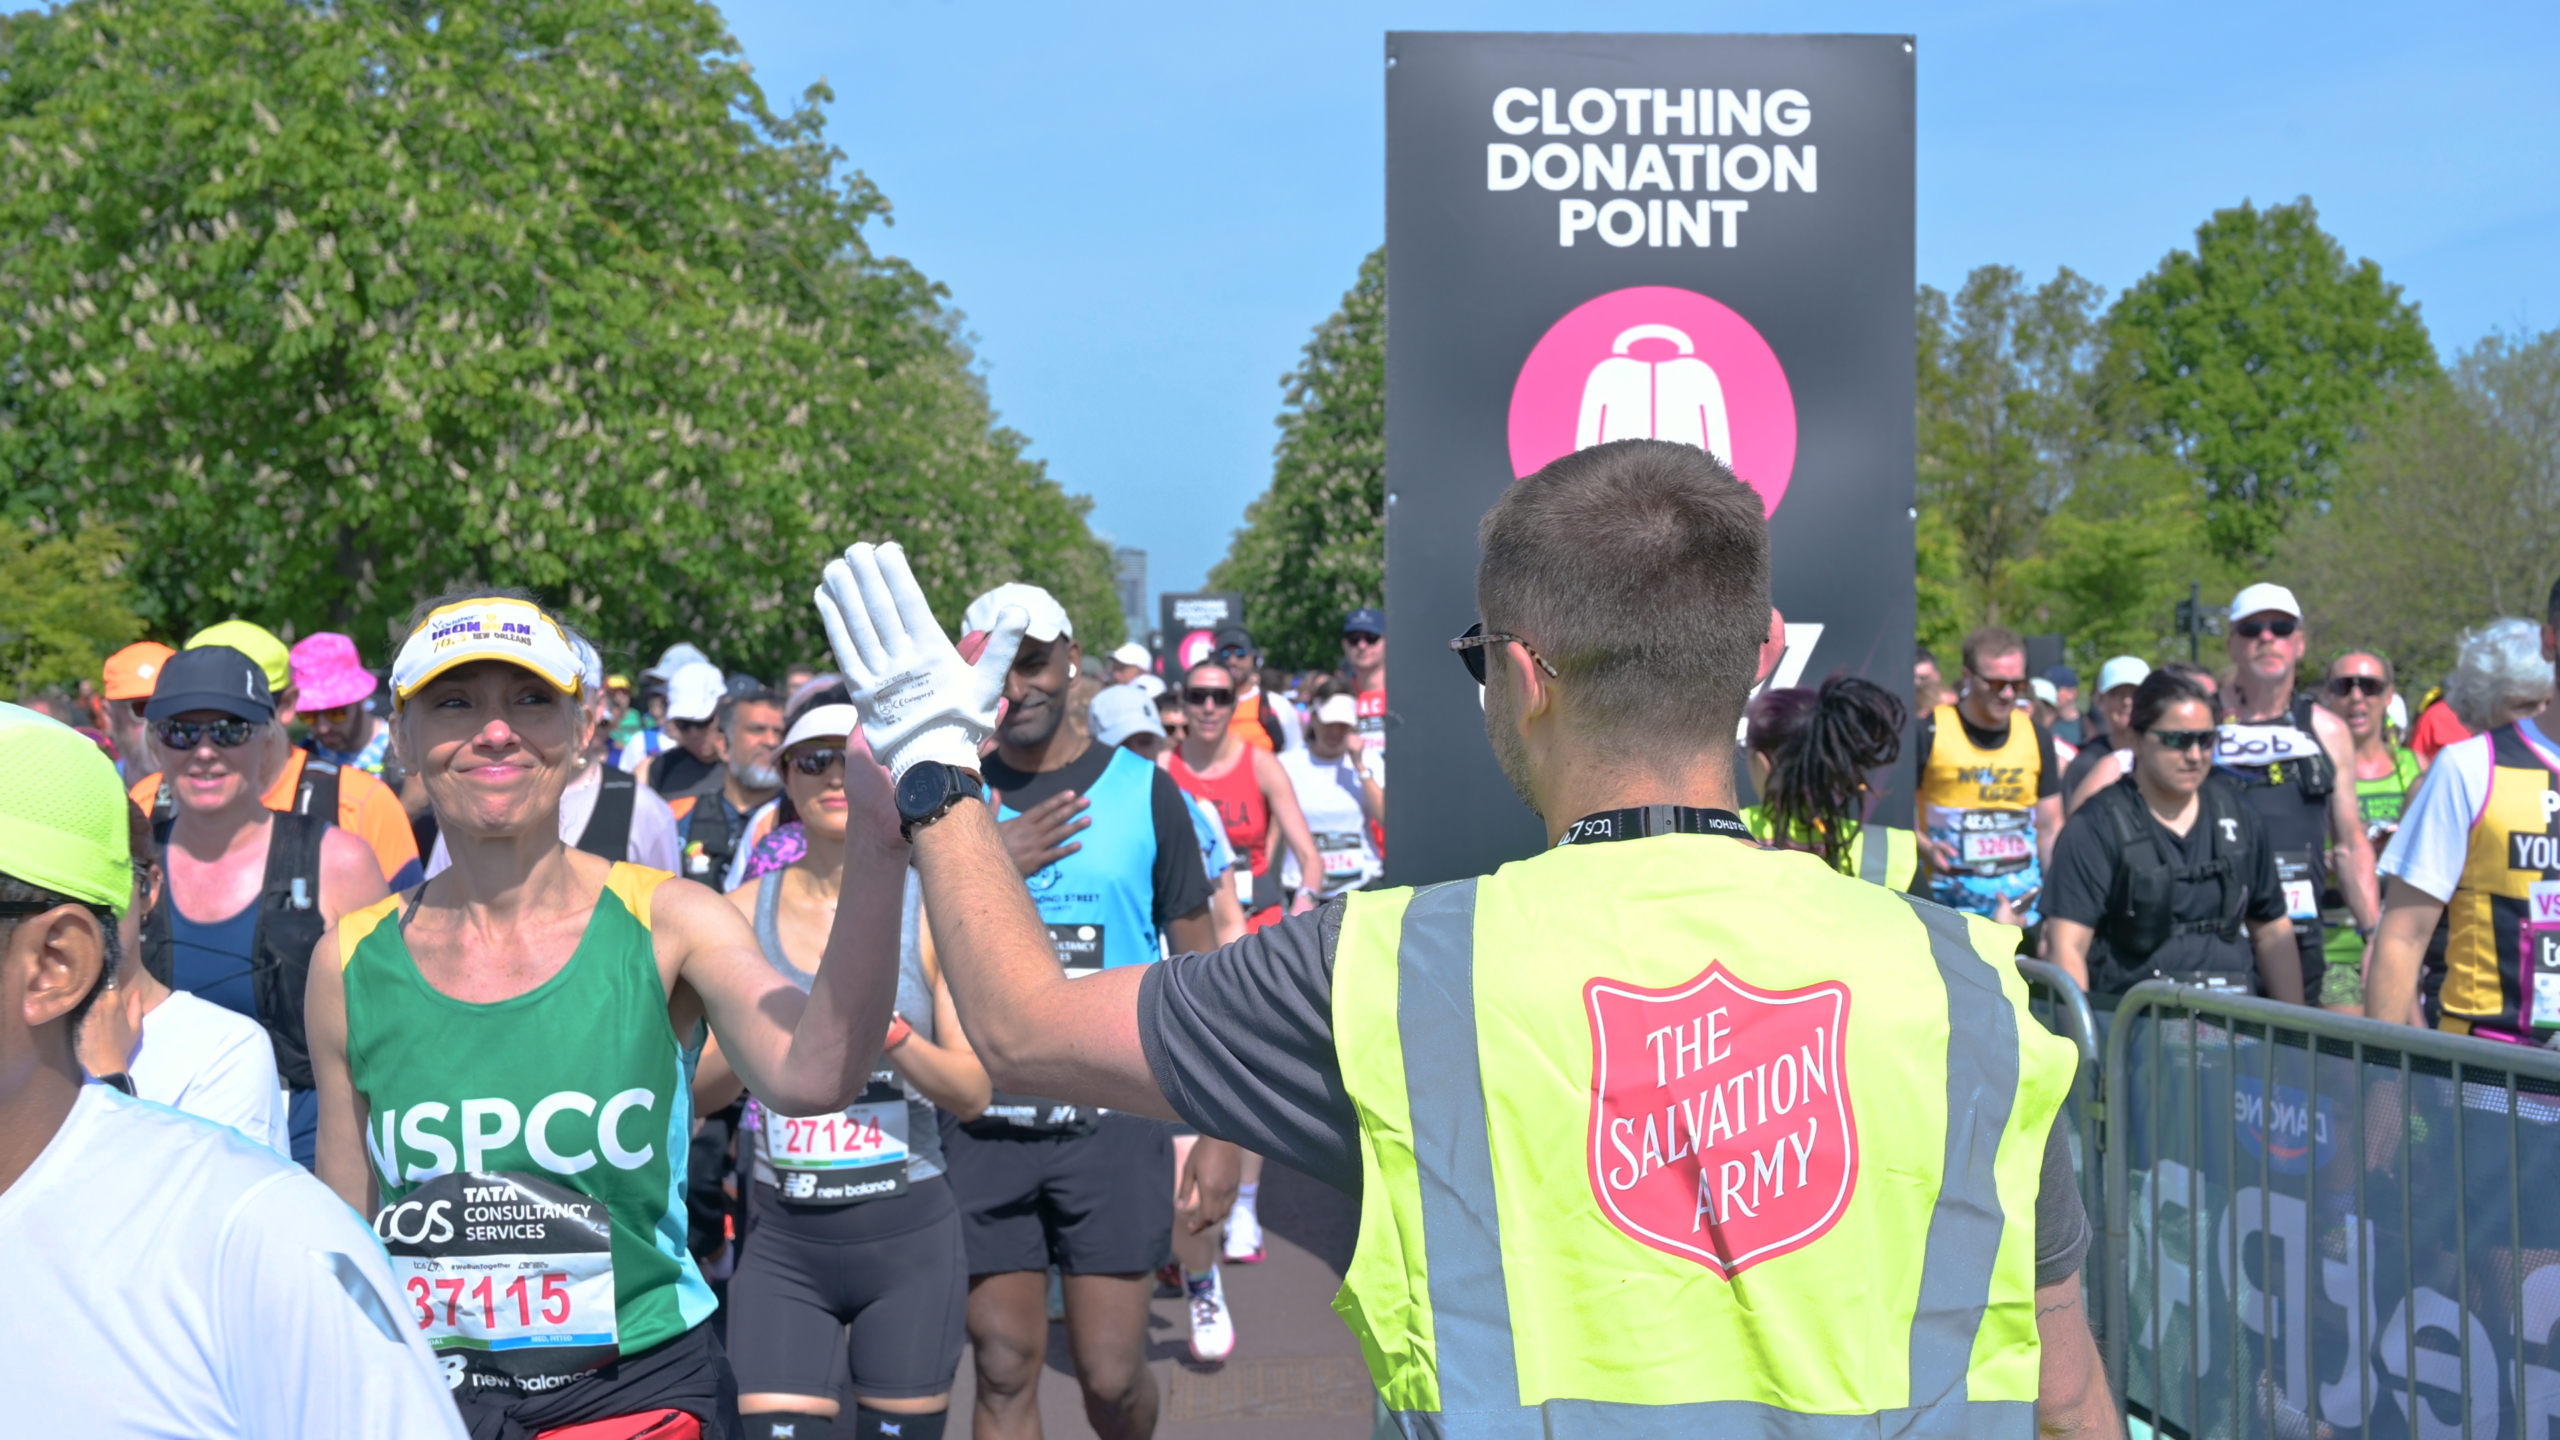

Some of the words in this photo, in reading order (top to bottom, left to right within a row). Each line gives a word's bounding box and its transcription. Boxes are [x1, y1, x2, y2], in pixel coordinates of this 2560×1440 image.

[1492, 87, 1811, 136] CLOTHING
[1487, 143, 1817, 193] DONATION
[1560, 199, 1748, 247] POINT
[473, 632, 490, 640] NEW
[2219, 734, 2293, 757] Bob
[1646, 1006, 1731, 1088] THE
[1609, 1027, 1827, 1190] SALVATION
[366, 1087, 655, 1189] NSPCC
[785, 1115, 884, 1153] 27124
[463, 1186, 518, 1203] TATA
[817, 1187, 844, 1199] new
[844, 1179, 897, 1197] balance
[1692, 1117, 1817, 1233] ARMY
[463, 1203, 591, 1222] CONSULTANCY
[466, 1223, 546, 1241] SERVICES
[407, 1273, 571, 1330] 37115
[472, 1372, 510, 1387] new
